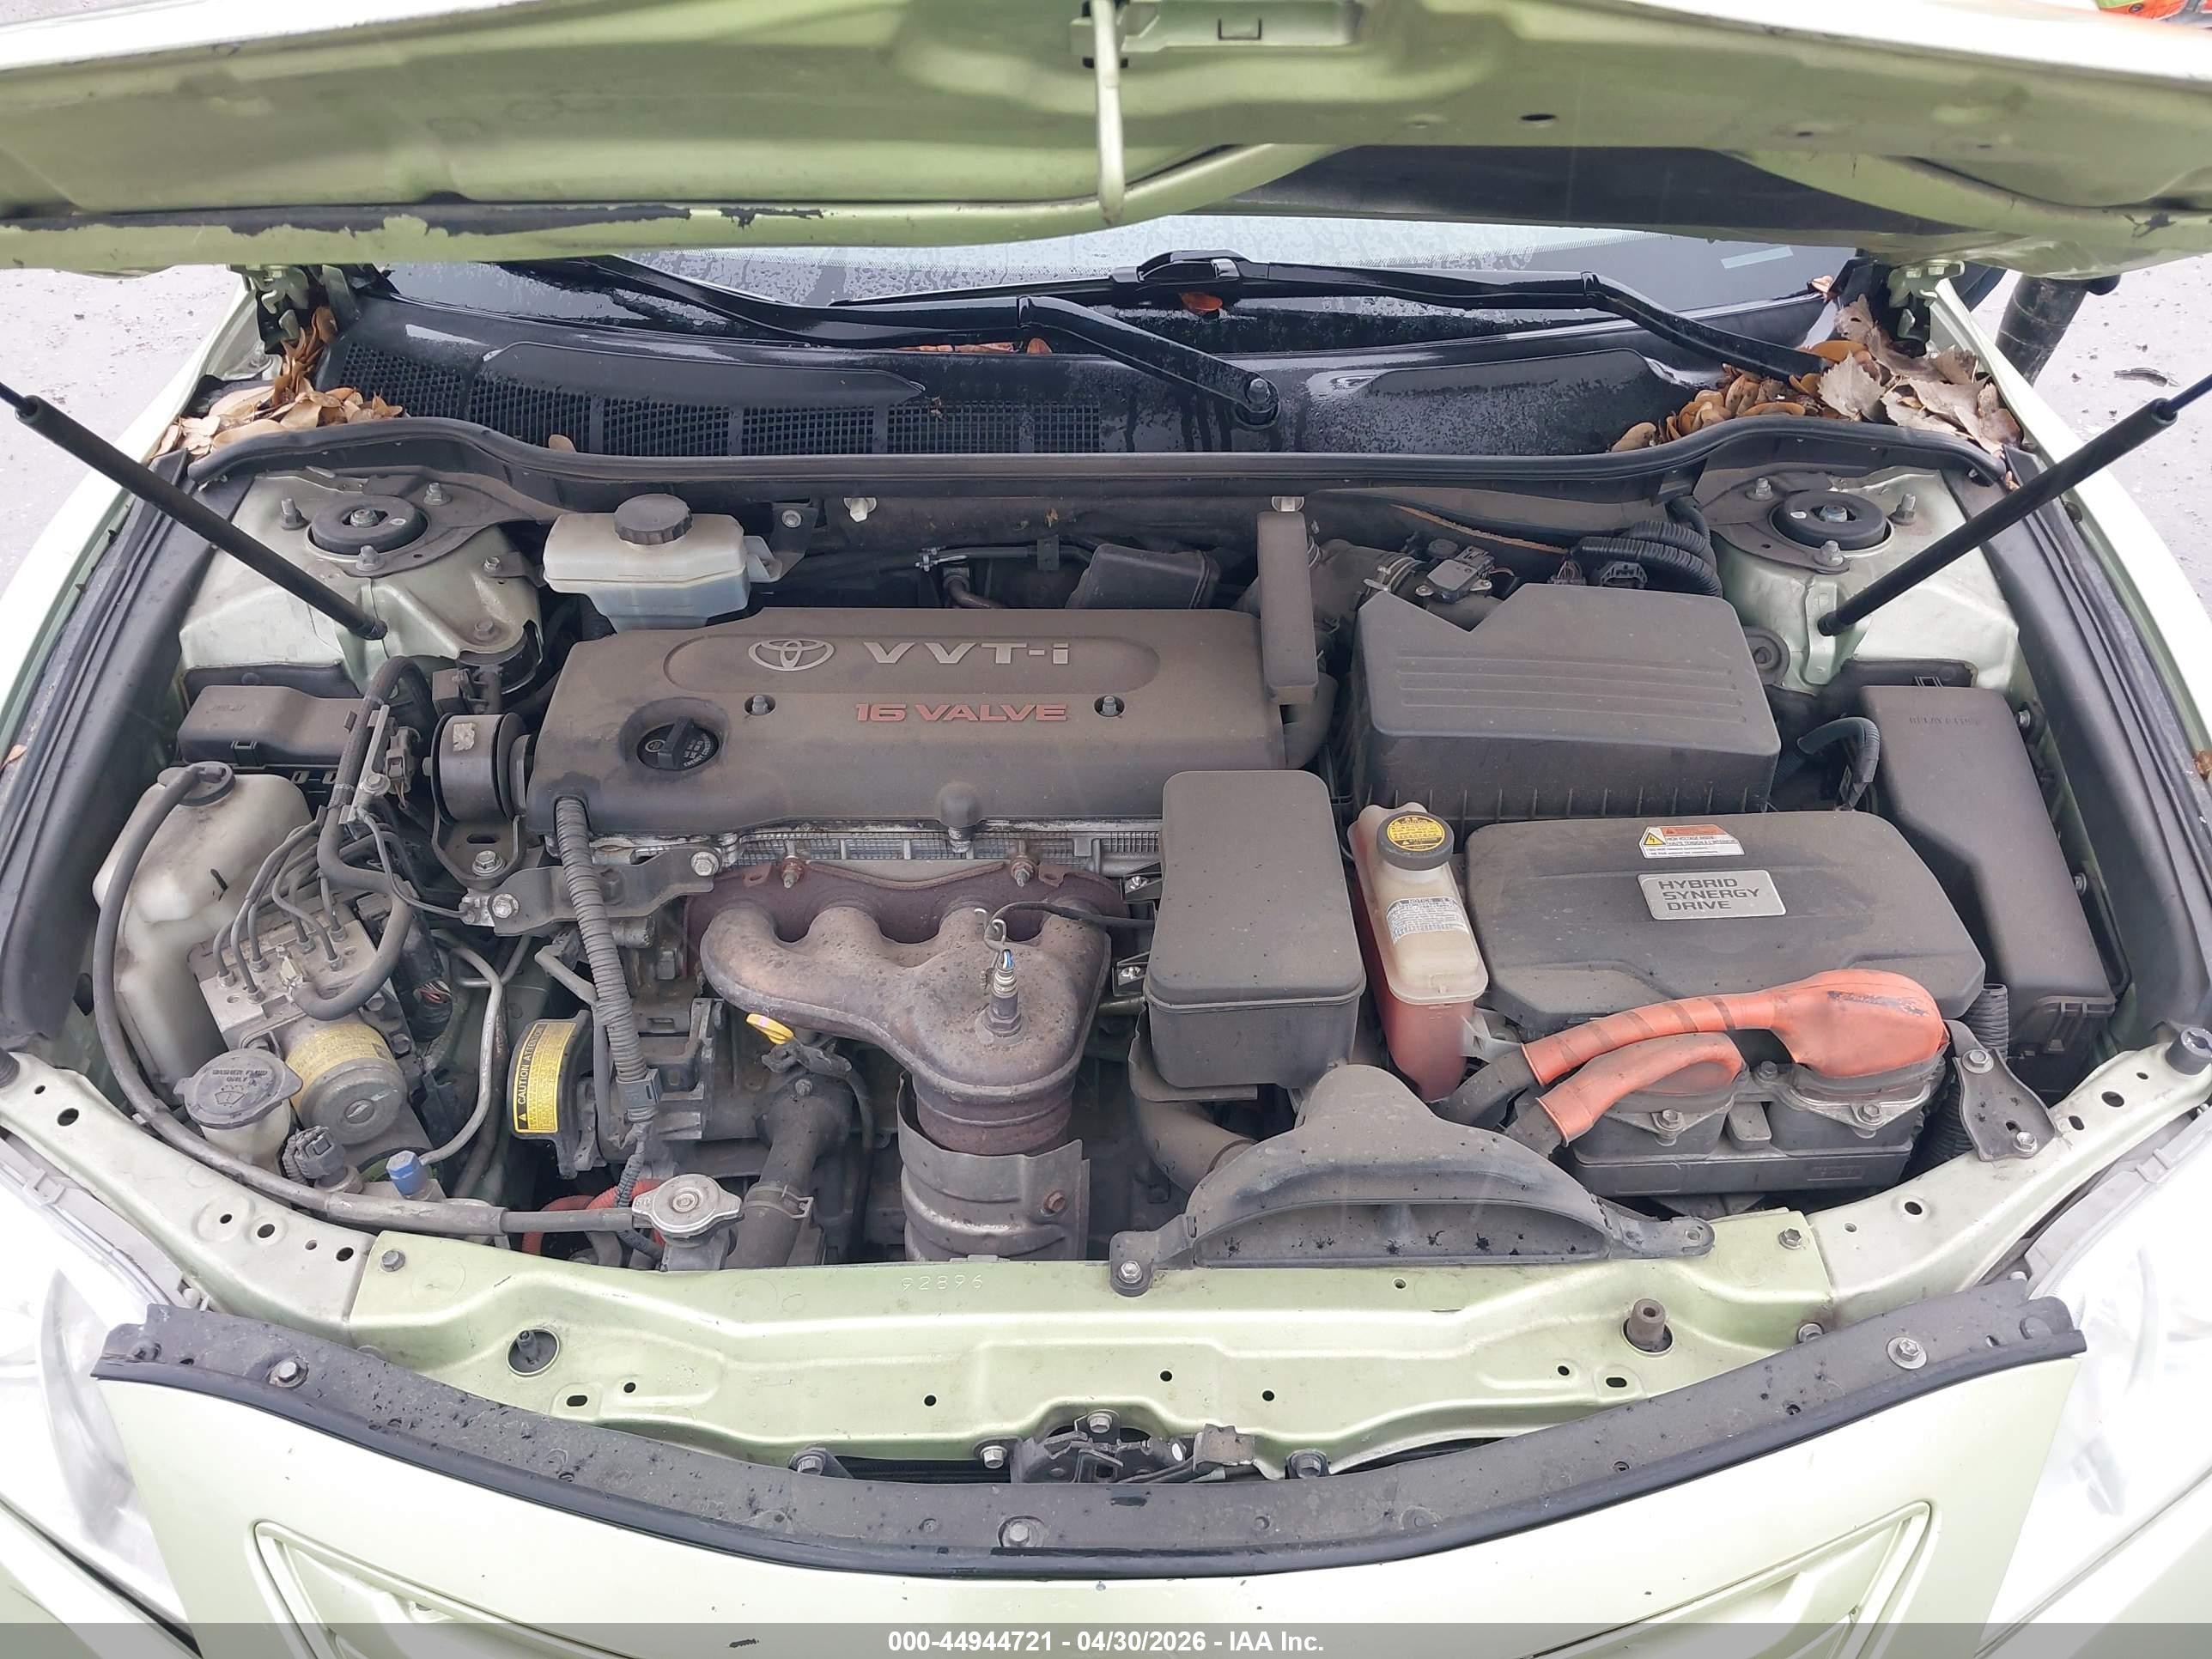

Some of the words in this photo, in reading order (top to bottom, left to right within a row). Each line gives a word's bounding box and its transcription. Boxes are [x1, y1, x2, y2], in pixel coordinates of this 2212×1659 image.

[863, 641, 1069, 665] VVT-i
[855, 703, 907, 721] 16
[915, 703, 1068, 721] VALVE
[1658, 878, 1738, 890] HYBRID
[1662, 888, 1759, 900] SYNERGY
[1668, 901, 1732, 911] DRIVE
[518, 1064, 530, 1105] CAUTION
[901, 1273, 983, 1291] 92896
